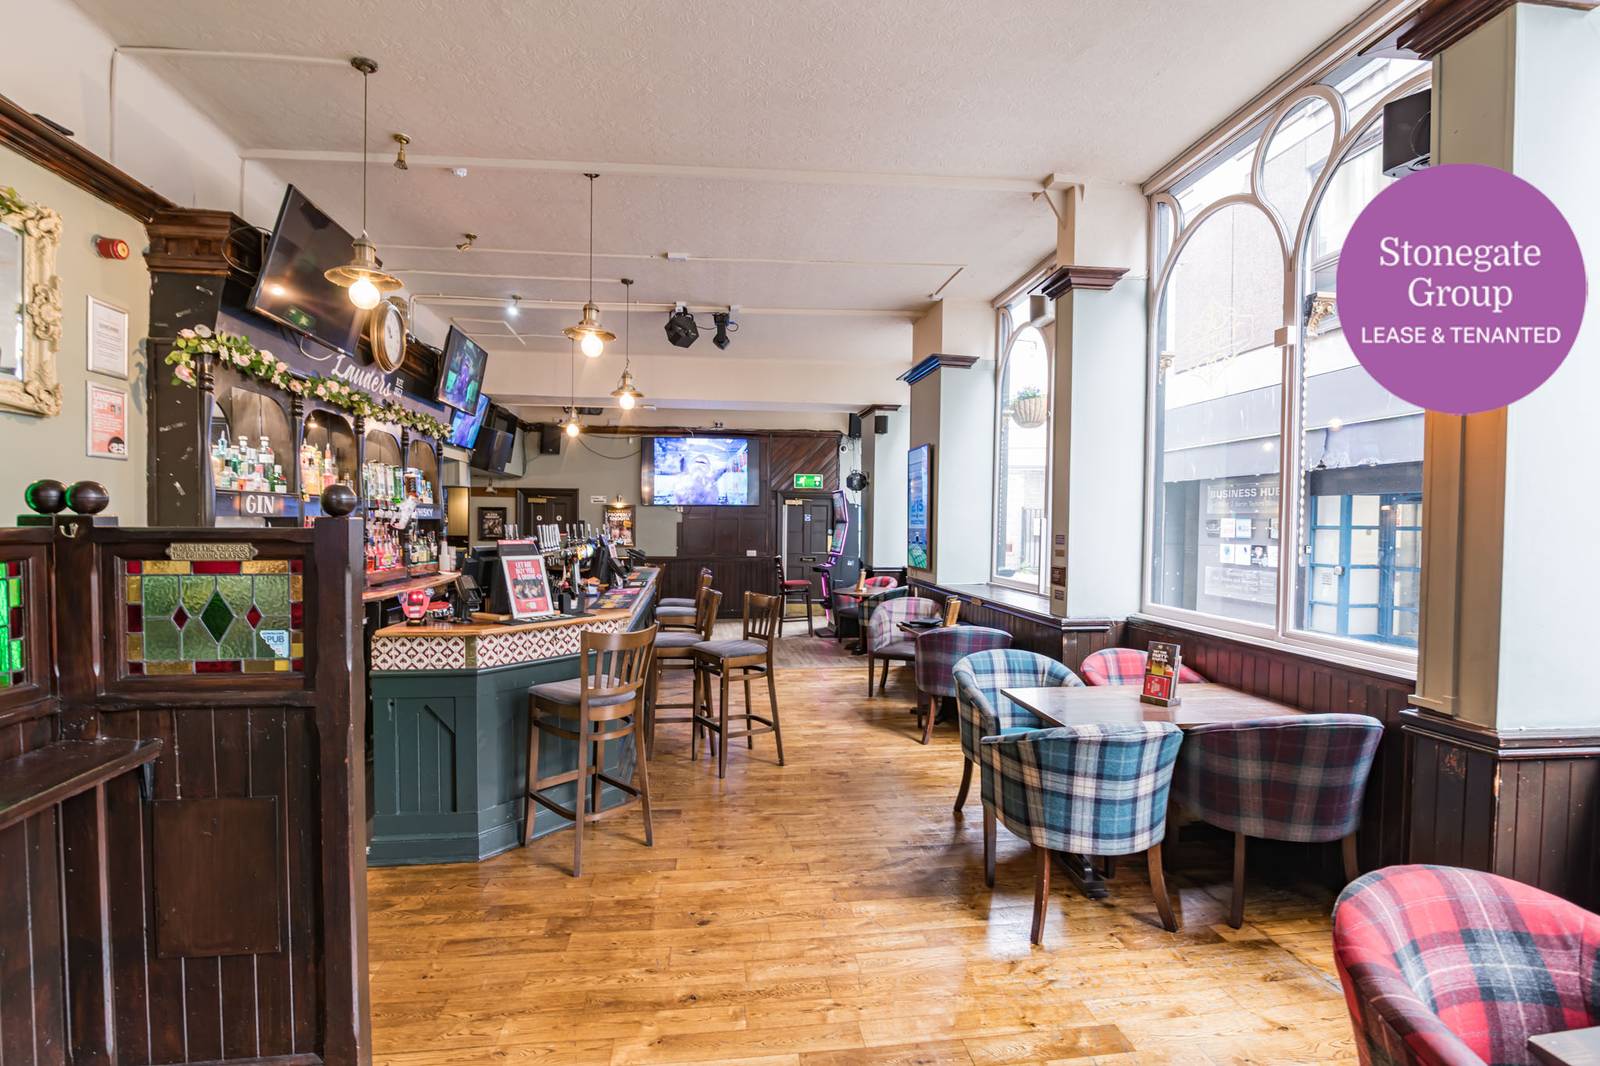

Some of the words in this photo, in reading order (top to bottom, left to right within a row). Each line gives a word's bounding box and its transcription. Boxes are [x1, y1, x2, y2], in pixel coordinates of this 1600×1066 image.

[1208, 487, 1257, 498] BUSINESS
[245, 494, 275, 514] GIN
[266, 635, 285, 643] PUB
